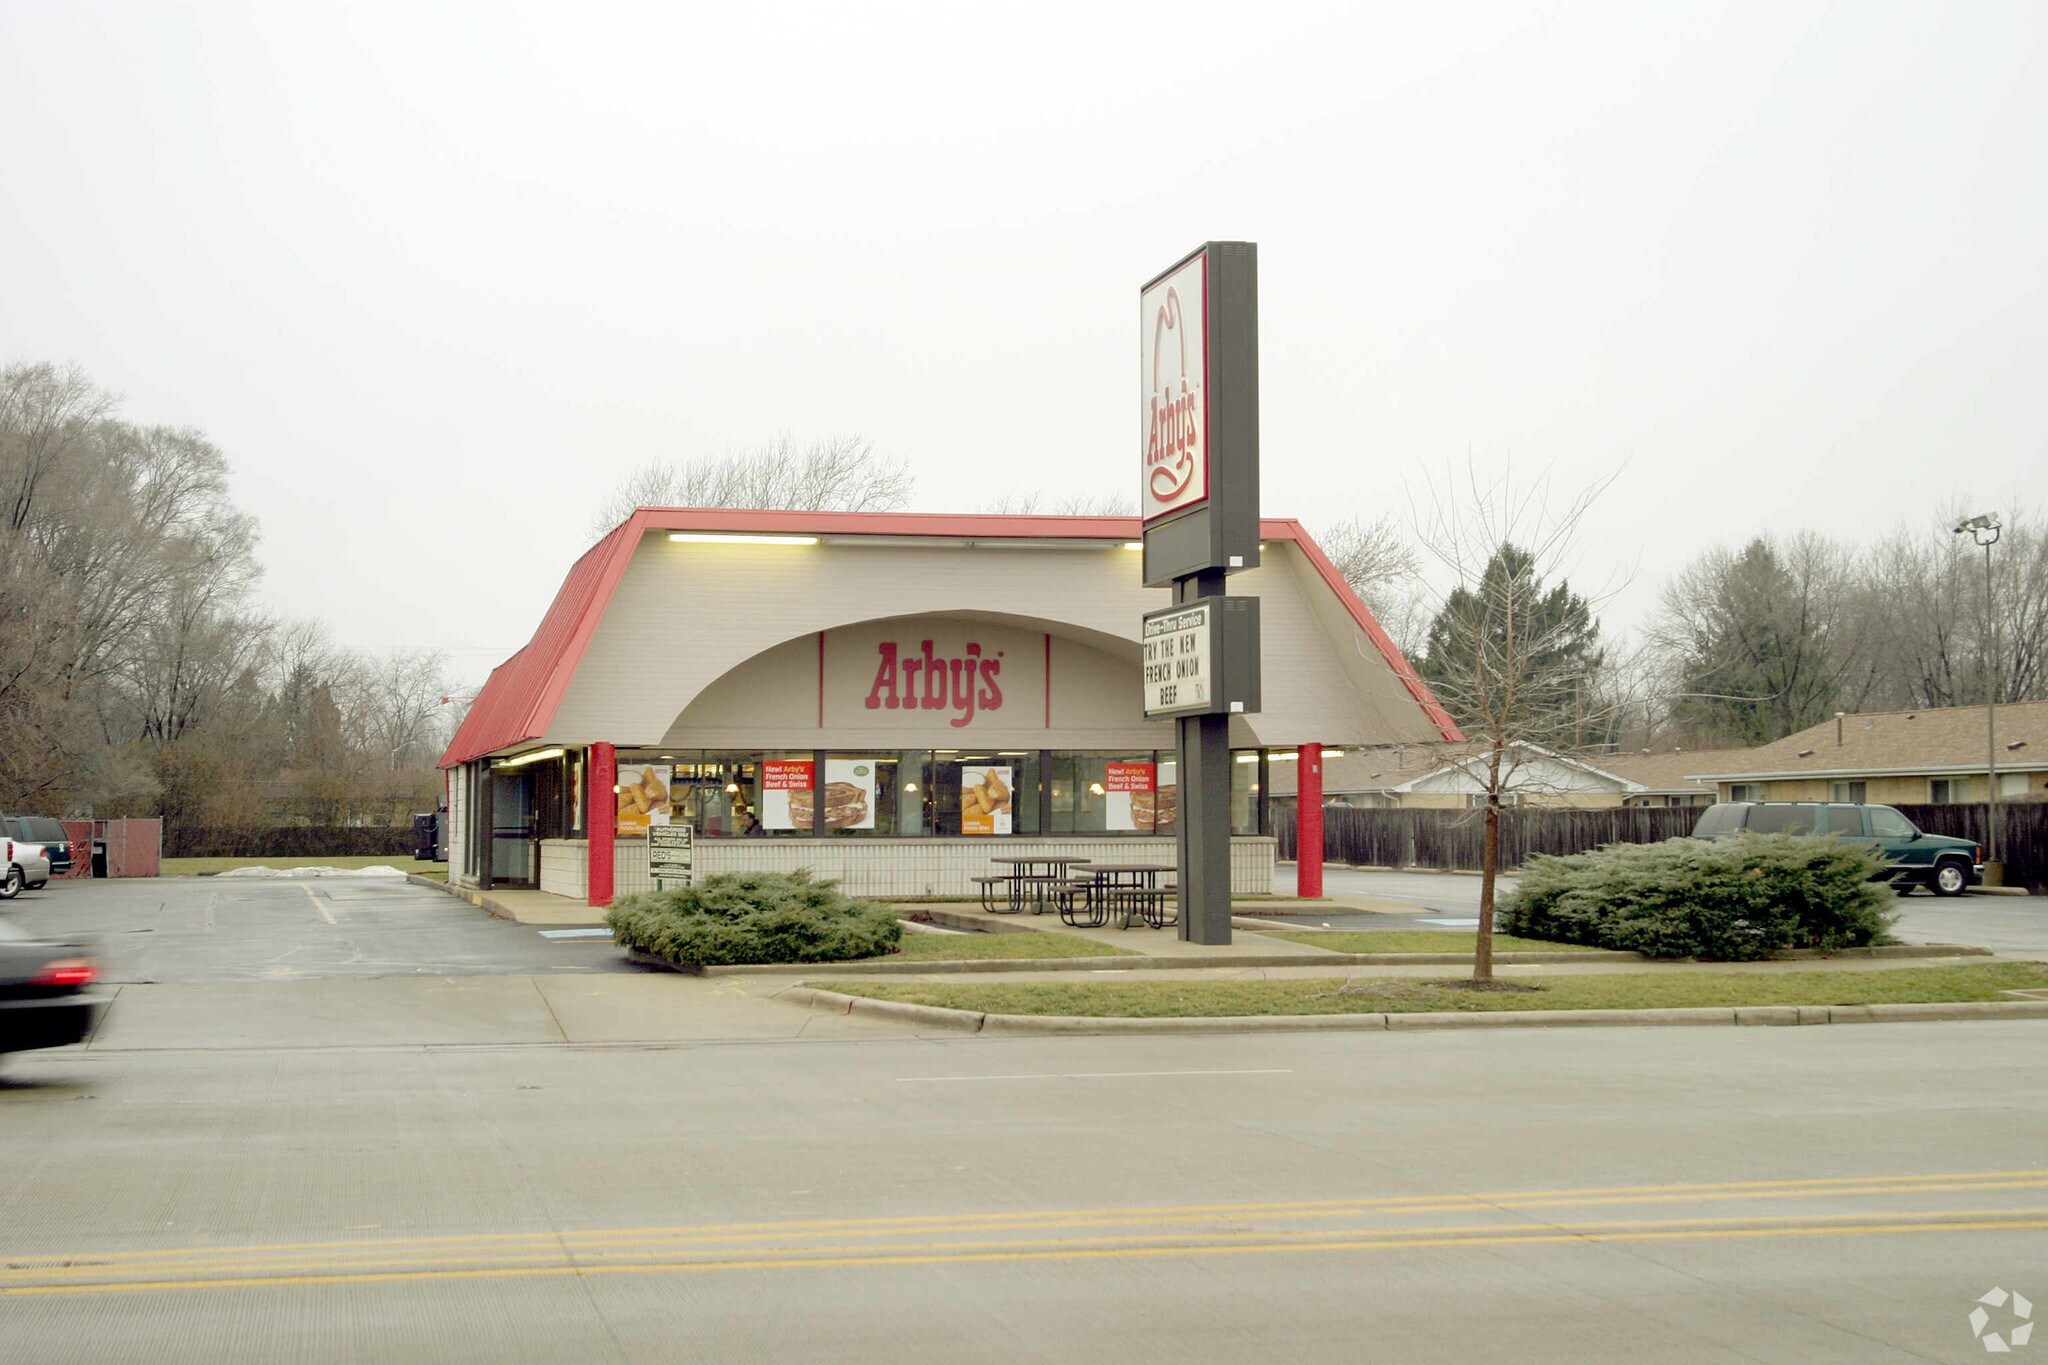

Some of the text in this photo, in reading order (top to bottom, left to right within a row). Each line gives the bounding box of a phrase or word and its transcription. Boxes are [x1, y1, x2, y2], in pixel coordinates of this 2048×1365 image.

[1147, 380, 1197, 470] Arby's
[1145, 613, 1202, 637] Drive-Thru Service
[1144, 633, 1196, 661] TRY THE NEW
[864, 639, 1004, 728] Arby's
[1145, 656, 1199, 684] FRENCH ONION
[1160, 685, 1177, 705] BEEF
